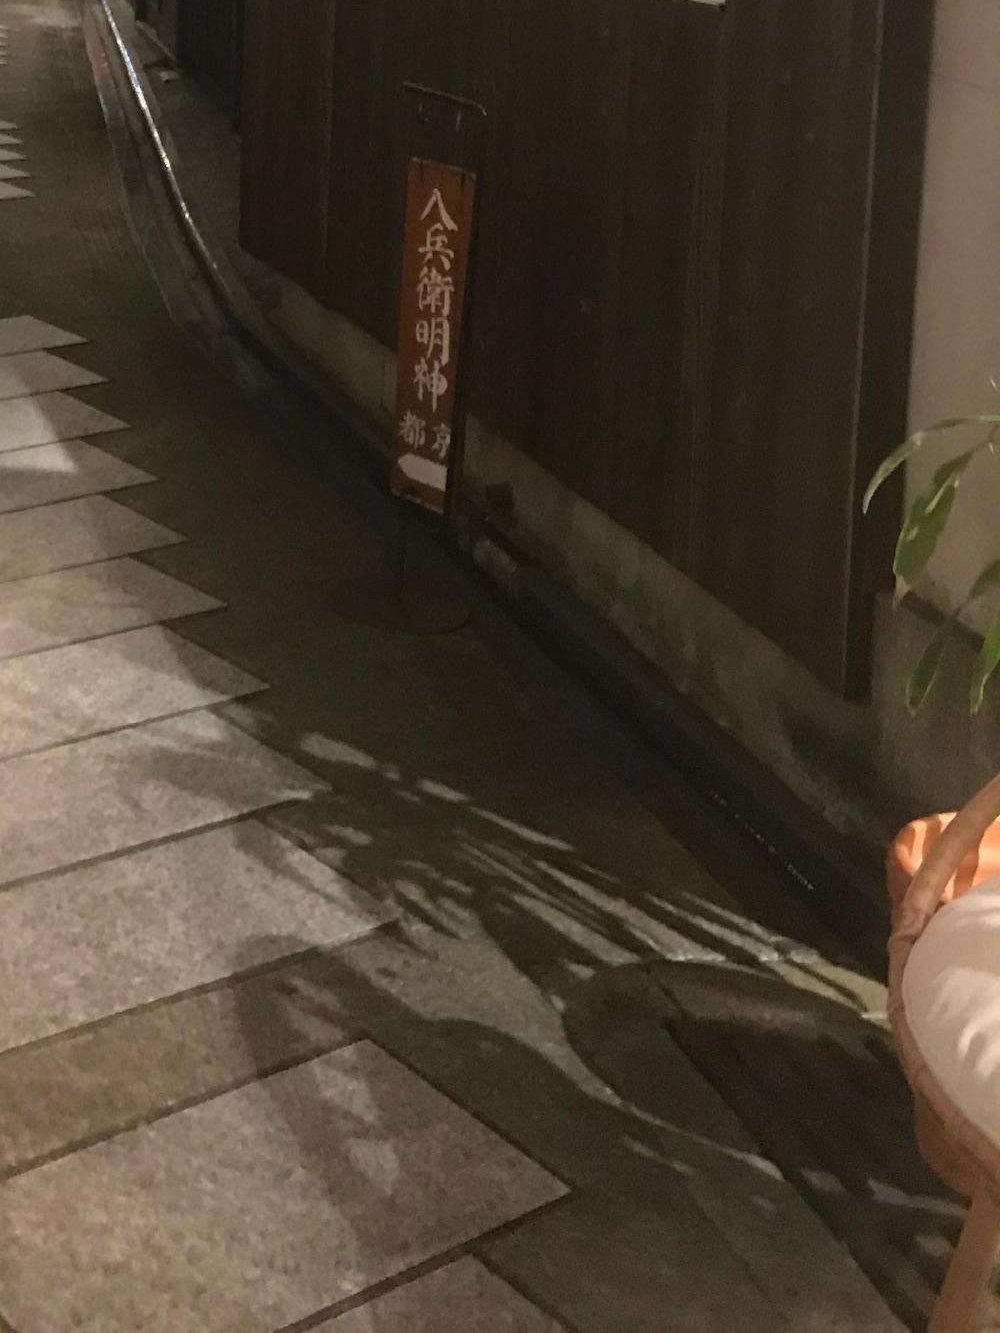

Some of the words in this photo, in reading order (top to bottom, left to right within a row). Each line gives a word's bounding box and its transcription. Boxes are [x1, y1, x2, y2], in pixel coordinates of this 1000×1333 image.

[414, 187, 458, 413] 八兵衛明神
